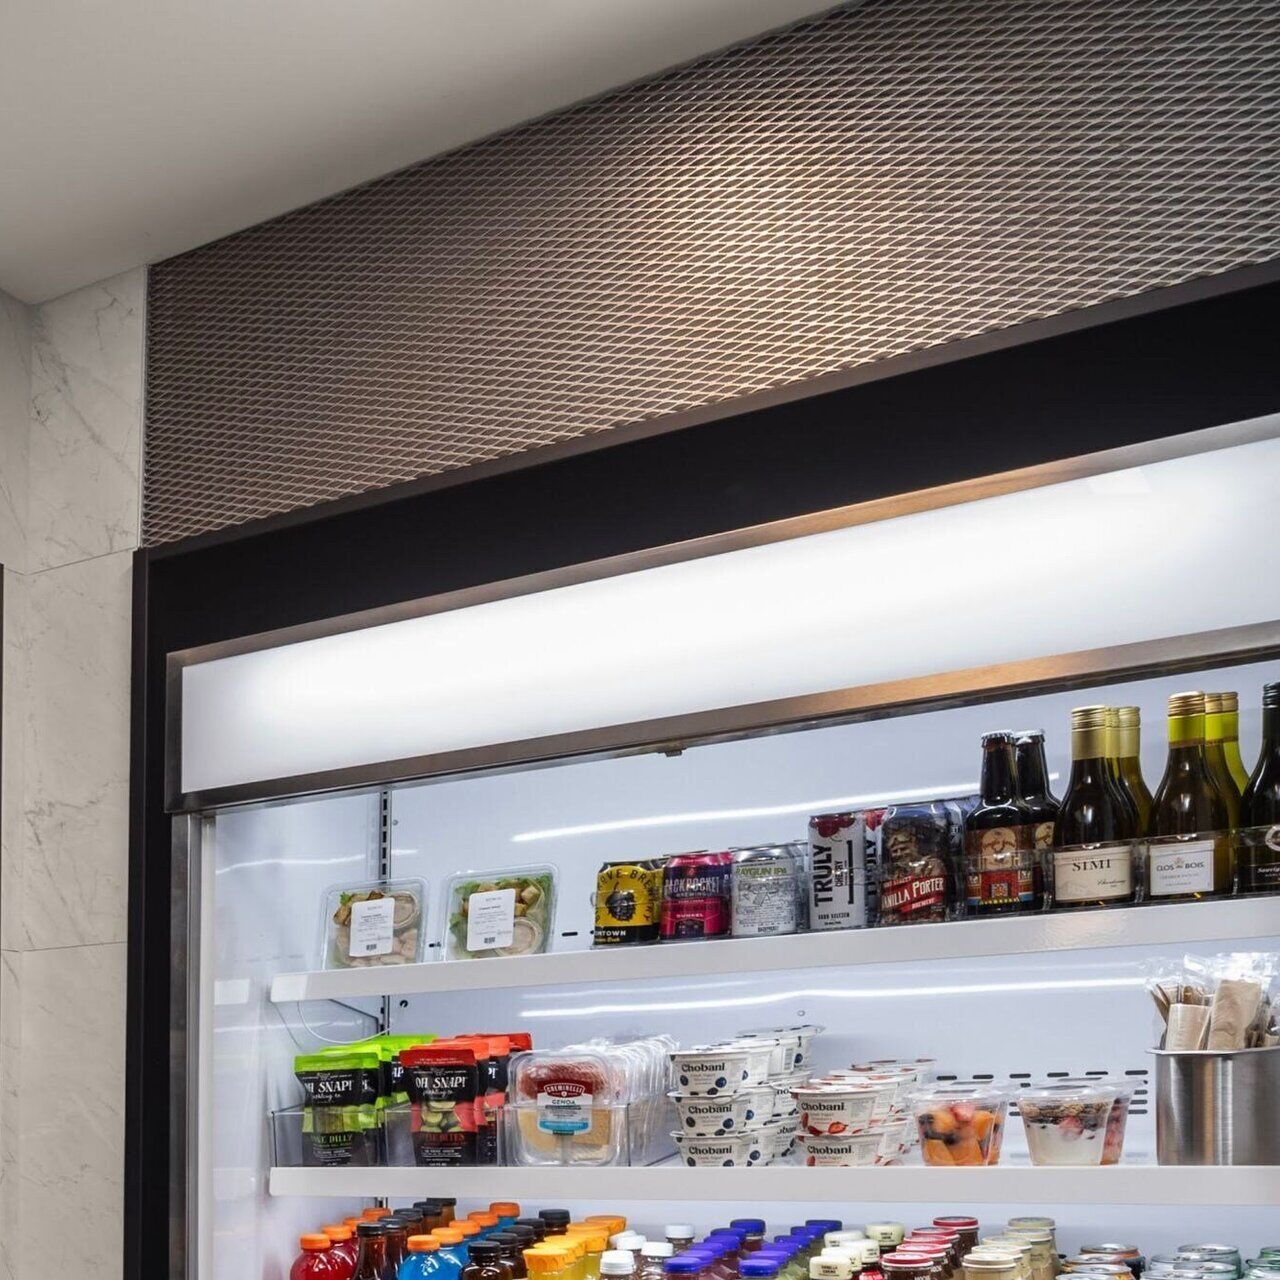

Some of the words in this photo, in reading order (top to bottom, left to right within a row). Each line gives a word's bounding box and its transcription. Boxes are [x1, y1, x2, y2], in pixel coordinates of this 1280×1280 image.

[1072, 858, 1112, 872] SIMI
[1157, 863, 1175, 872] CLOS
[1185, 861, 1204, 870] BOIS
[774, 867, 788, 876] IPA
[813, 844, 833, 908] TRULY
[912, 877, 944, 898] PORTER
[681, 1062, 725, 1073] Chobani
[319, 1079, 353, 1092] SNAP!
[415, 1077, 429, 1089] OH
[434, 1076, 467, 1088] SNAP!
[688, 1103, 733, 1114] Chobani
[801, 1102, 845, 1111] Chobani
[689, 1145, 732, 1155] Chobani
[807, 1144, 852, 1155] Chobani
